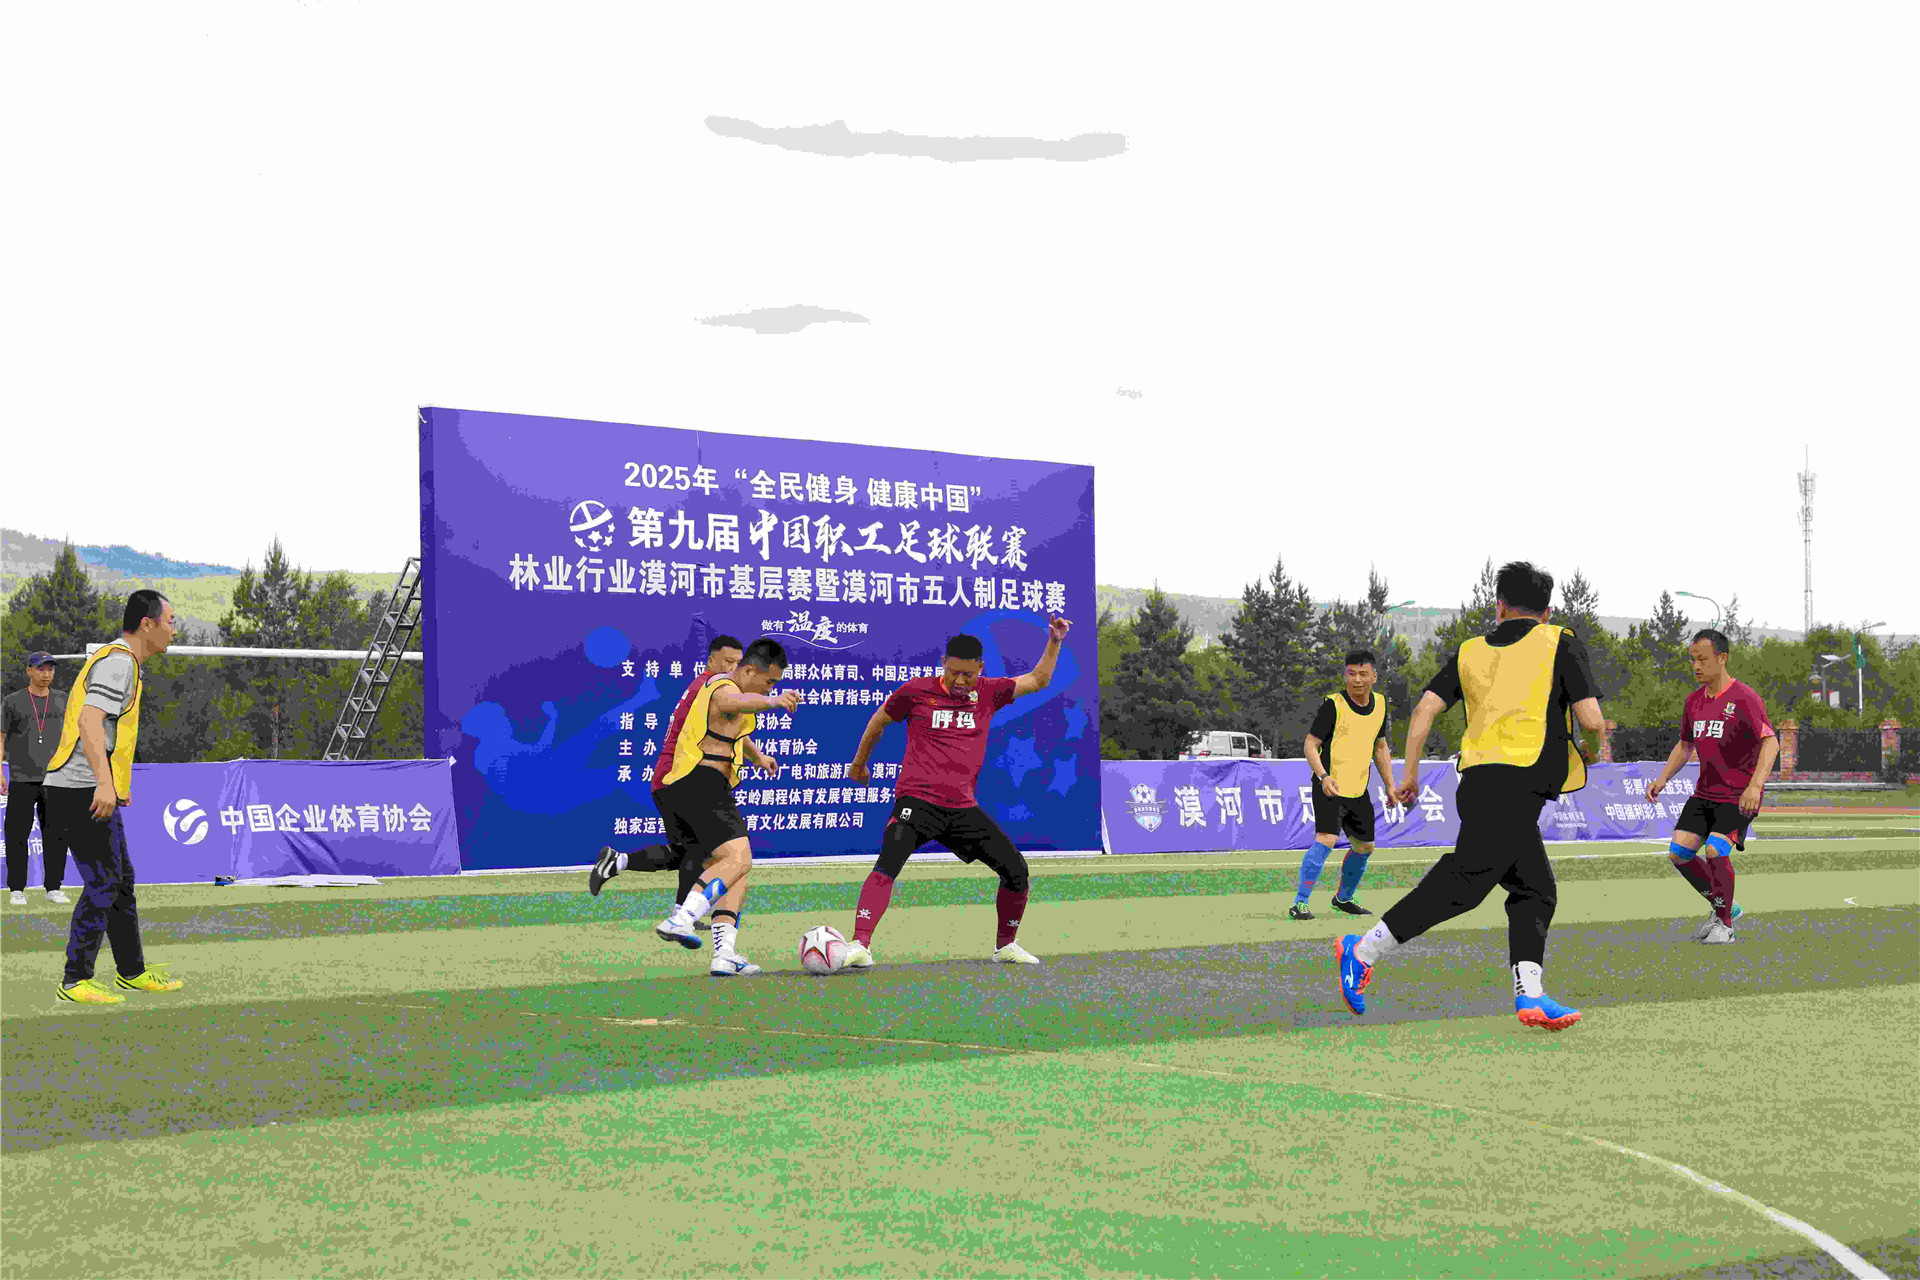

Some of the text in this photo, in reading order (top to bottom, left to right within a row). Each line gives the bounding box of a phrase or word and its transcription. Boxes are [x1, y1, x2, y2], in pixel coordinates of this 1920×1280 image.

[624, 461, 719, 495] 2025年
[508, 552, 1067, 615] 林业行业漠河市基层赛暨漠河市五人制足球赛
[931, 709, 976, 729] 呼玛
[735, 786, 895, 806] 安岭鹏程体育发展管理服务
[220, 802, 433, 834] 中国企业体育协会
[743, 812, 864, 832] 育文化发展有限公司
